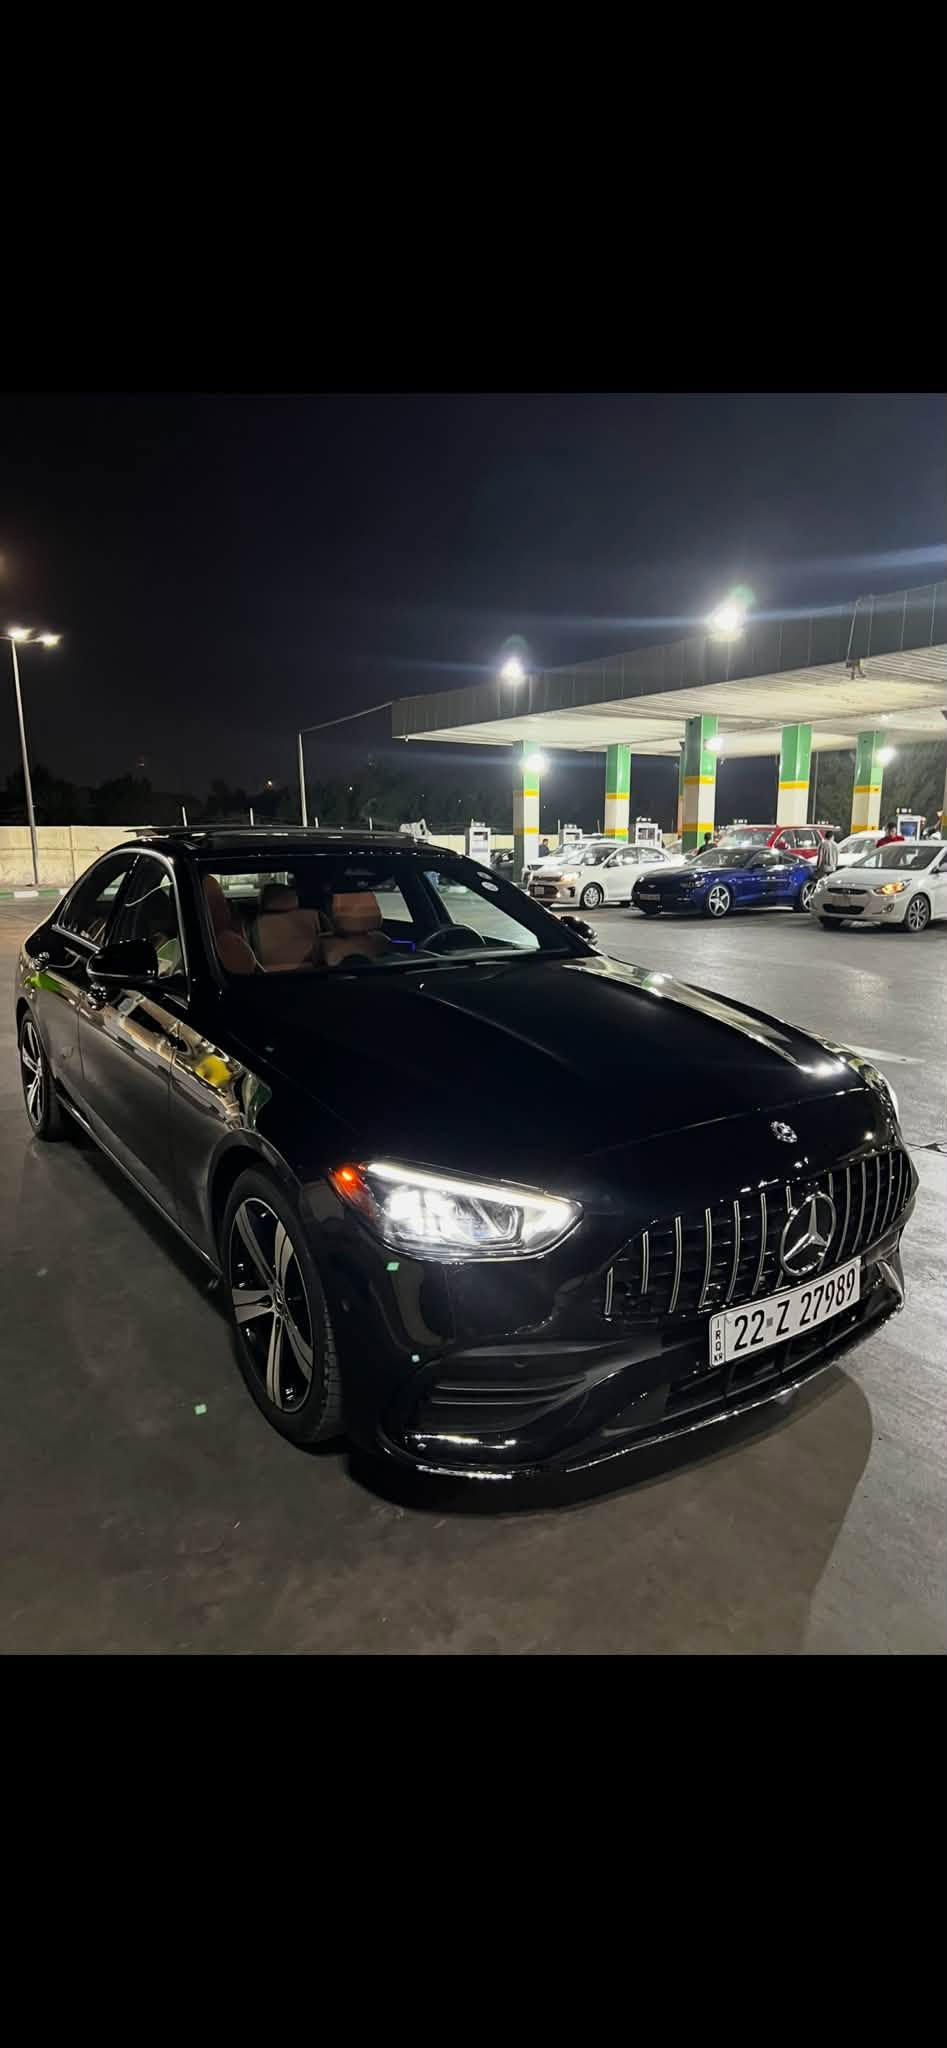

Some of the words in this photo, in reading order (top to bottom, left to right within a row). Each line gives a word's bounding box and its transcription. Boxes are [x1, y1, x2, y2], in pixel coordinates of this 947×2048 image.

[734, 1309, 765, 1351] 22
[776, 1299, 790, 1336] Z
[799, 1268, 855, 1326] 27989
